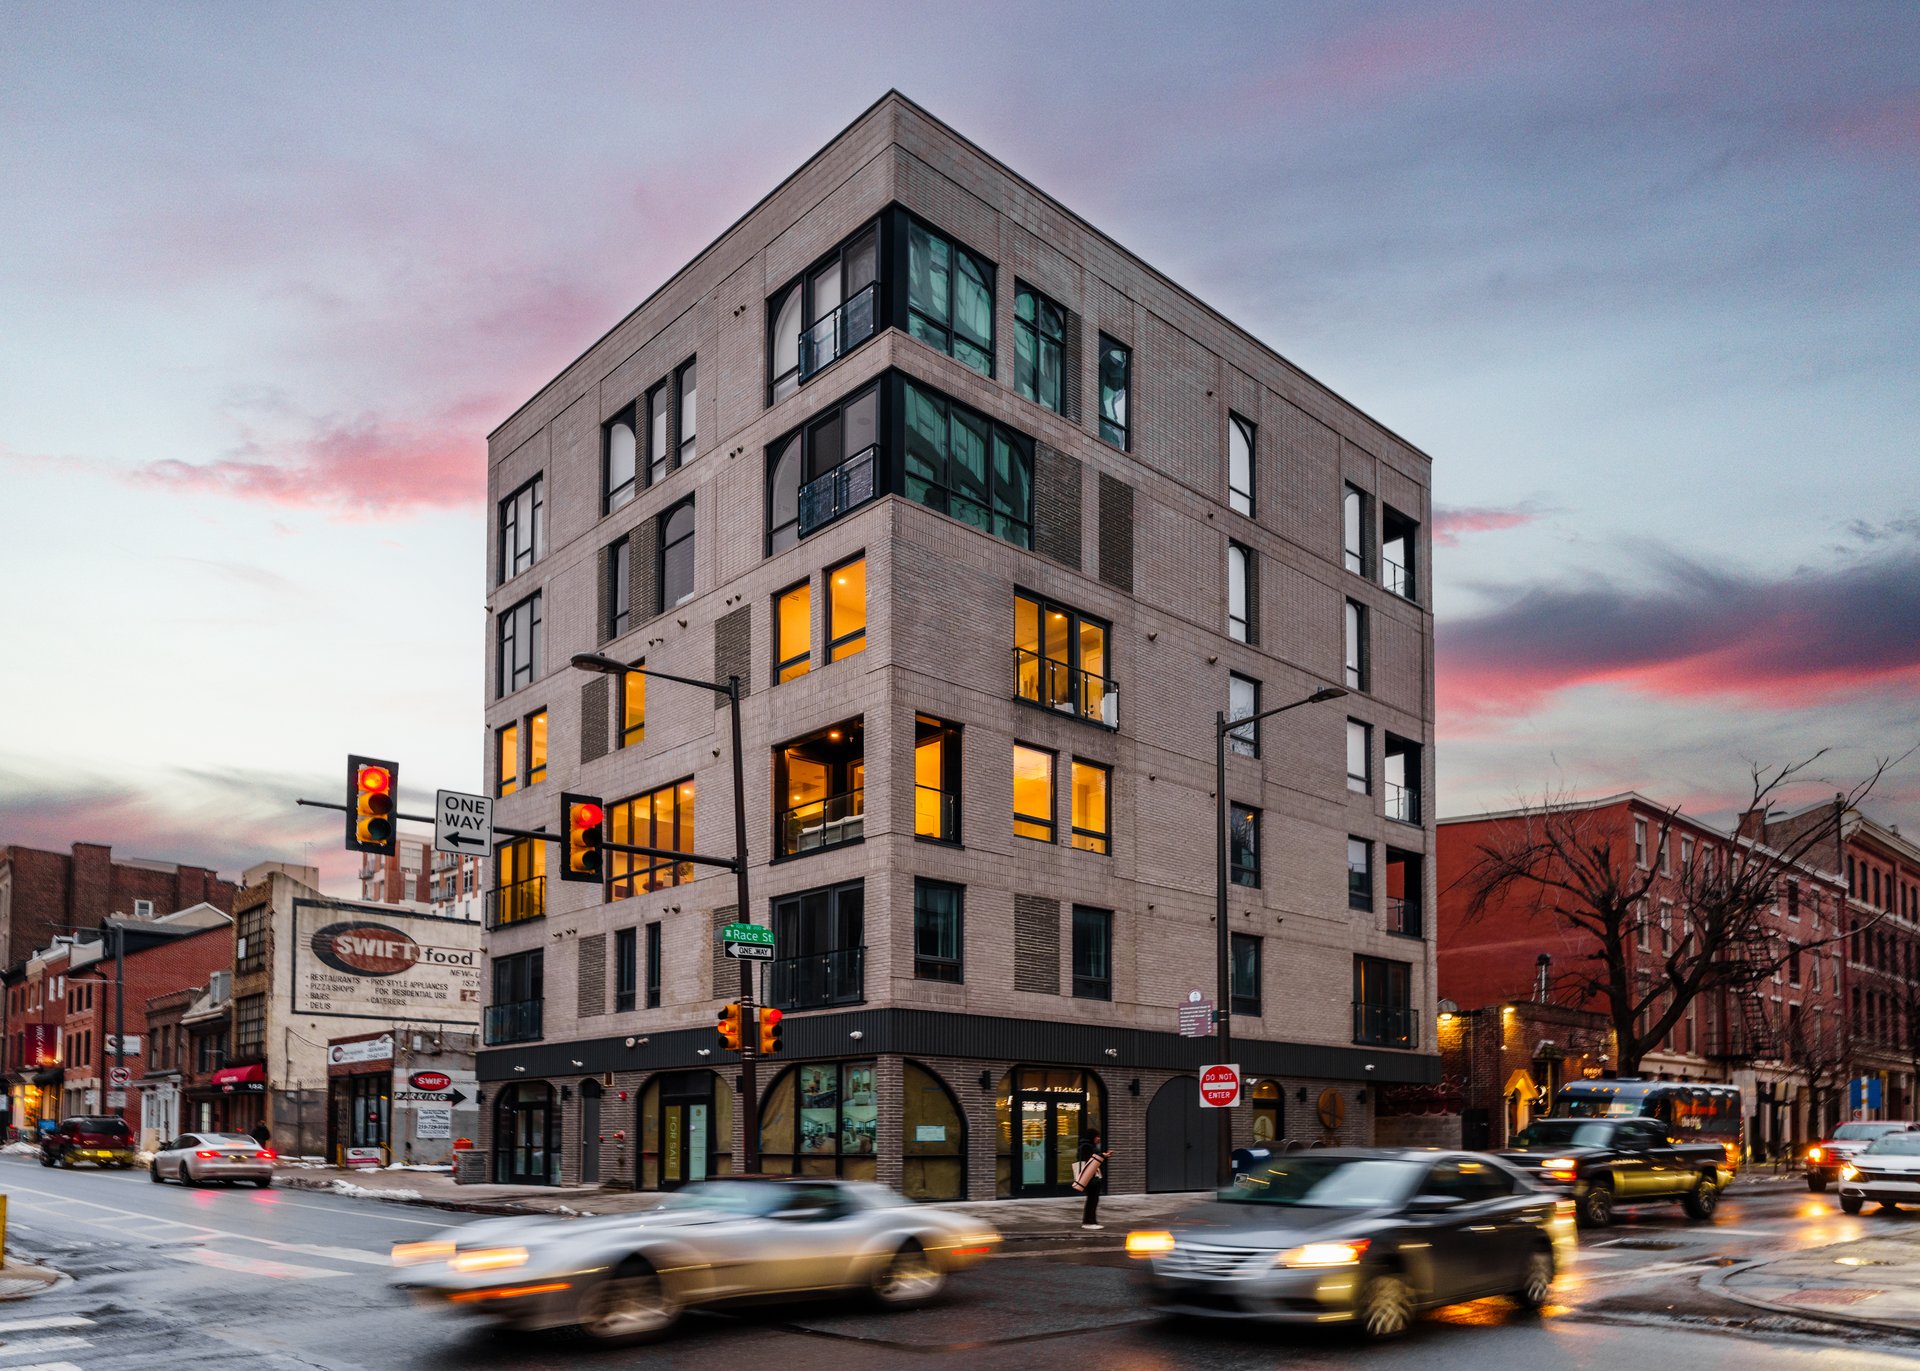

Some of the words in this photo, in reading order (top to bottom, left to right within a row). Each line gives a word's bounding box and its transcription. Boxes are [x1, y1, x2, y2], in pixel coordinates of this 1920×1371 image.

[445, 796, 486, 815] ONE
[445, 812, 485, 831] WAY
[733, 929, 759, 941] Race
[762, 932, 773, 943] St
[336, 935, 416, 960] SWIFT
[424, 948, 474, 966] food
[738, 946, 753, 955] ONE
[310, 973, 361, 985] RESTAURANTS
[310, 982, 331, 991] PIZZA
[331, 984, 355, 993] SHOPS
[370, 979, 408, 988] PRO-STYLE
[409, 981, 449, 991] APPLIANCES
[310, 992, 330, 1000] BARS
[375, 987, 389, 995] FOR
[391, 988, 433, 998] RESIDENTIAL
[433, 992, 447, 1000] USE
[310, 1001, 331, 1010] DELIS
[370, 996, 407, 1006] CATERERS
[417, 1077, 450, 1086] SWIFT
[1205, 1073, 1216, 1082] DO
[1218, 1073, 1233, 1081] NOT
[395, 1092, 448, 1101] PARKING
[1208, 1091, 1231, 1099] ENTER
[669, 1116, 677, 1139] FOR
[669, 1142, 677, 1169] SALE
